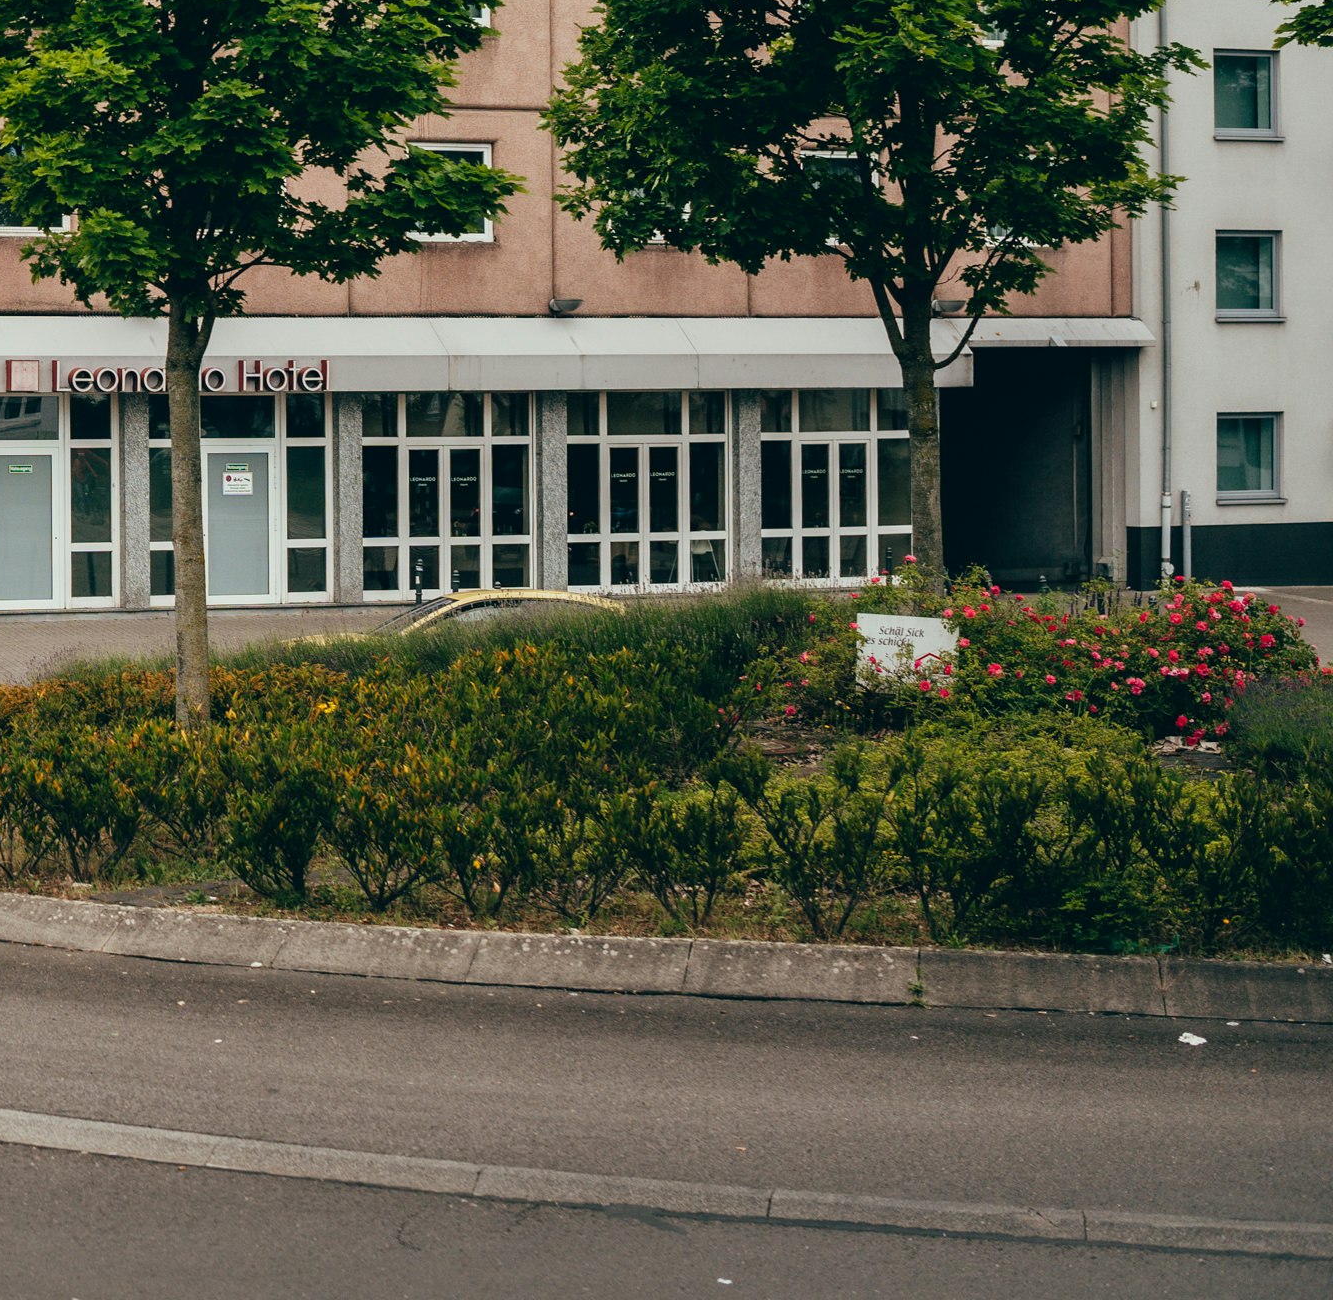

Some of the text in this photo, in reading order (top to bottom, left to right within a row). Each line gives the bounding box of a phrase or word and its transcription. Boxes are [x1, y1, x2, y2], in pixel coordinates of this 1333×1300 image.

[52, 359, 330, 393] Leonao Hotel
[878, 626, 925, 638] Schäl Sick
